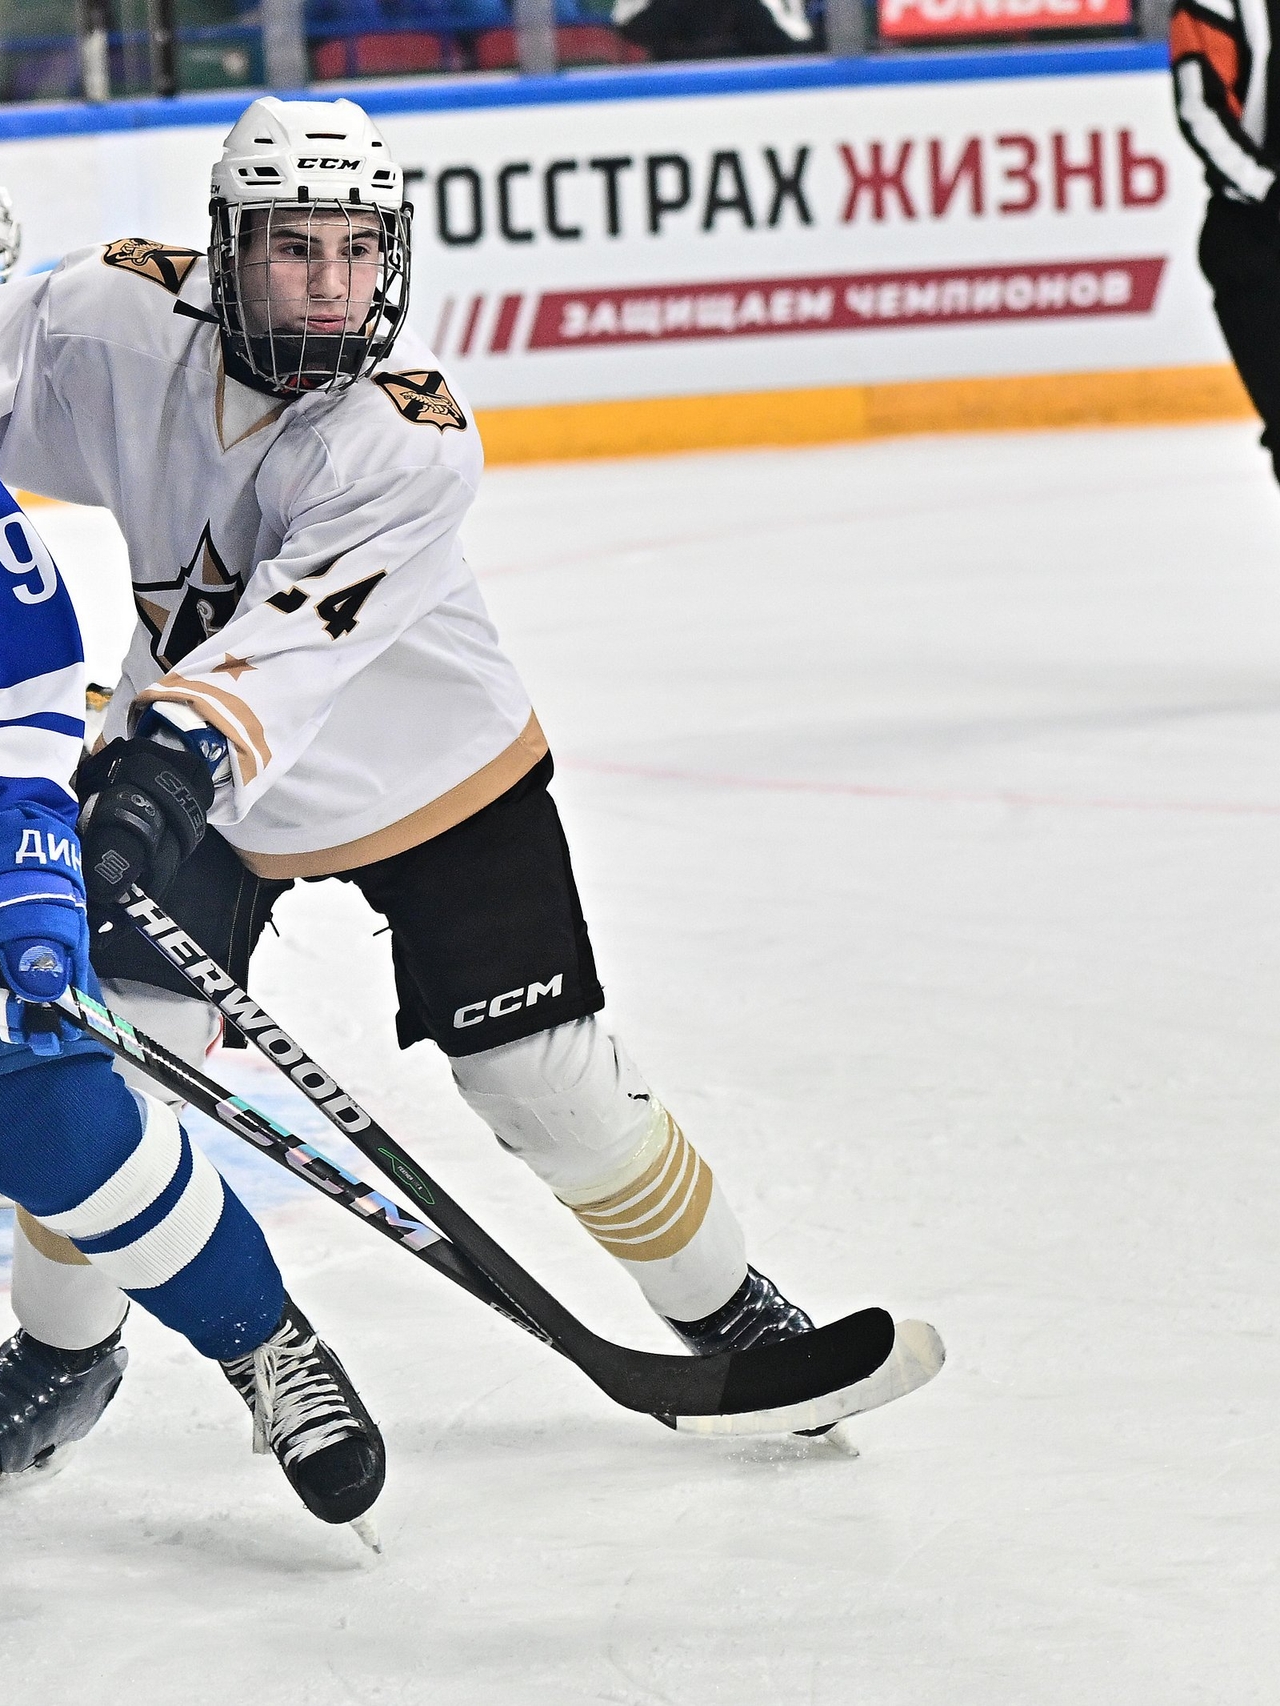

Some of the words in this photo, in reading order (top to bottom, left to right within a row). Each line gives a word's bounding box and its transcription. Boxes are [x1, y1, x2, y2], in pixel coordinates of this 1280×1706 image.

[296, 157, 361, 171] CCM
[836, 127, 1168, 224] ЖИЗНЬ
[559, 284, 836, 341] ЗАЩИЩАЕМ
[844, 269, 1134, 320] ЧЕМПИОНОВ
[453, 973, 564, 1029] CCM
